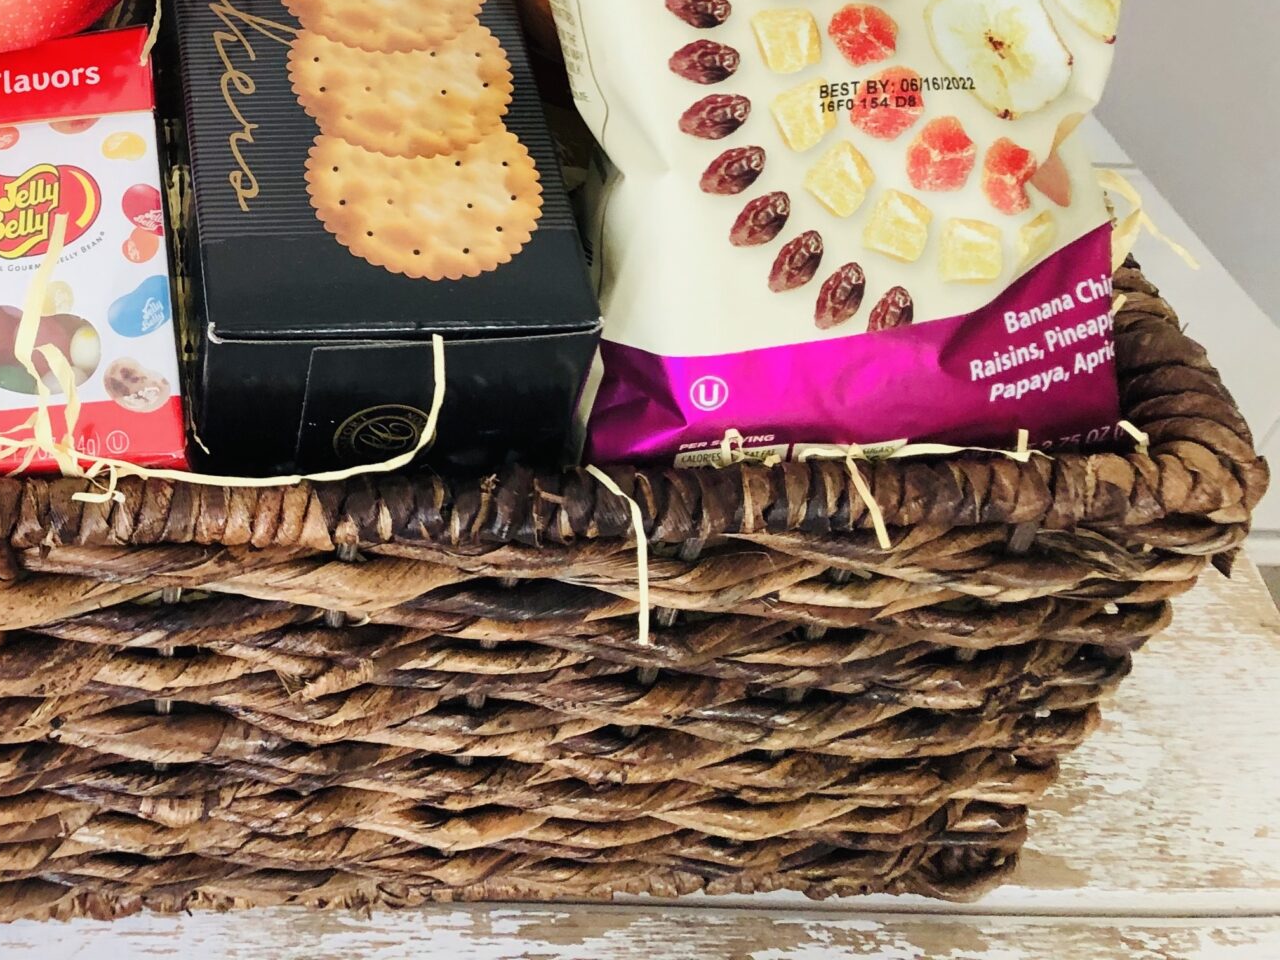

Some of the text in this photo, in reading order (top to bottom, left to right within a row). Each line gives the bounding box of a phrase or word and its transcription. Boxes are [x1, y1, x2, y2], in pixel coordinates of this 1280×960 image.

[819, 76, 976, 99] BEST BY: 06/16/2022
[1003, 293, 1075, 334] Banana
[969, 342, 1045, 381] Raisins,
[989, 365, 1071, 402] Papaya,
[678, 442, 709, 451] PER
